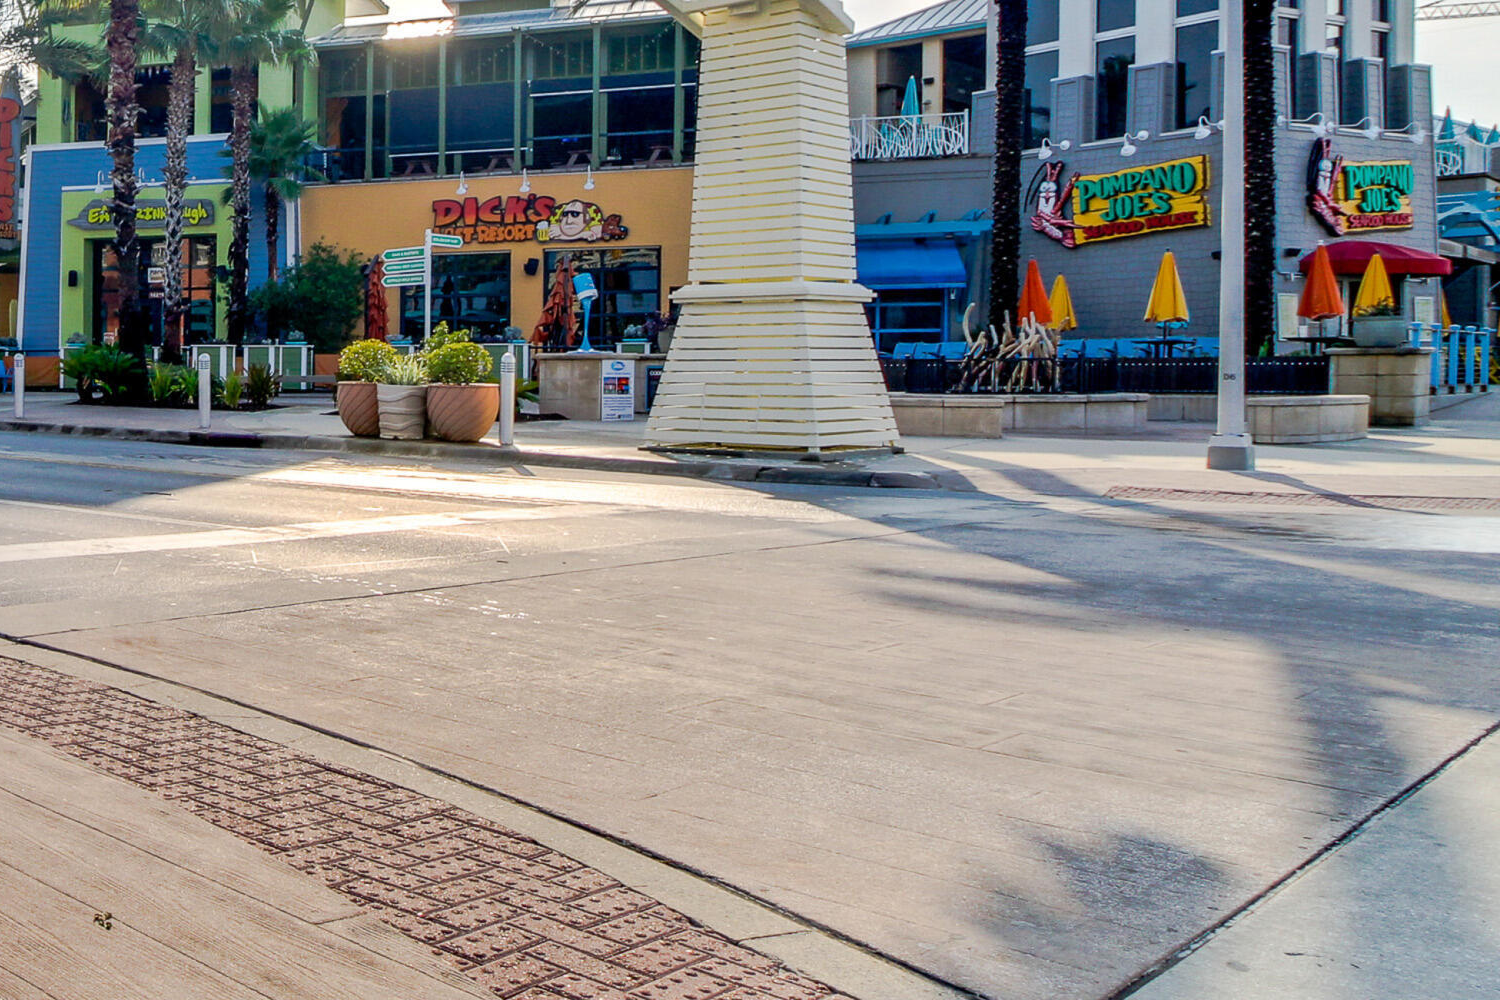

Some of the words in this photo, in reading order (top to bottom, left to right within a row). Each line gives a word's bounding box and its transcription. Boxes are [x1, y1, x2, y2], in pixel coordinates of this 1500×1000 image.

[1074, 161, 1197, 214] POMPANO
[1345, 164, 1414, 200] POMPANO
[432, 193, 556, 227] DICK'S
[1100, 191, 1172, 222] JOE'S
[1360, 187, 1402, 212] JOE'S
[476, 224, 535, 244] RESORT
